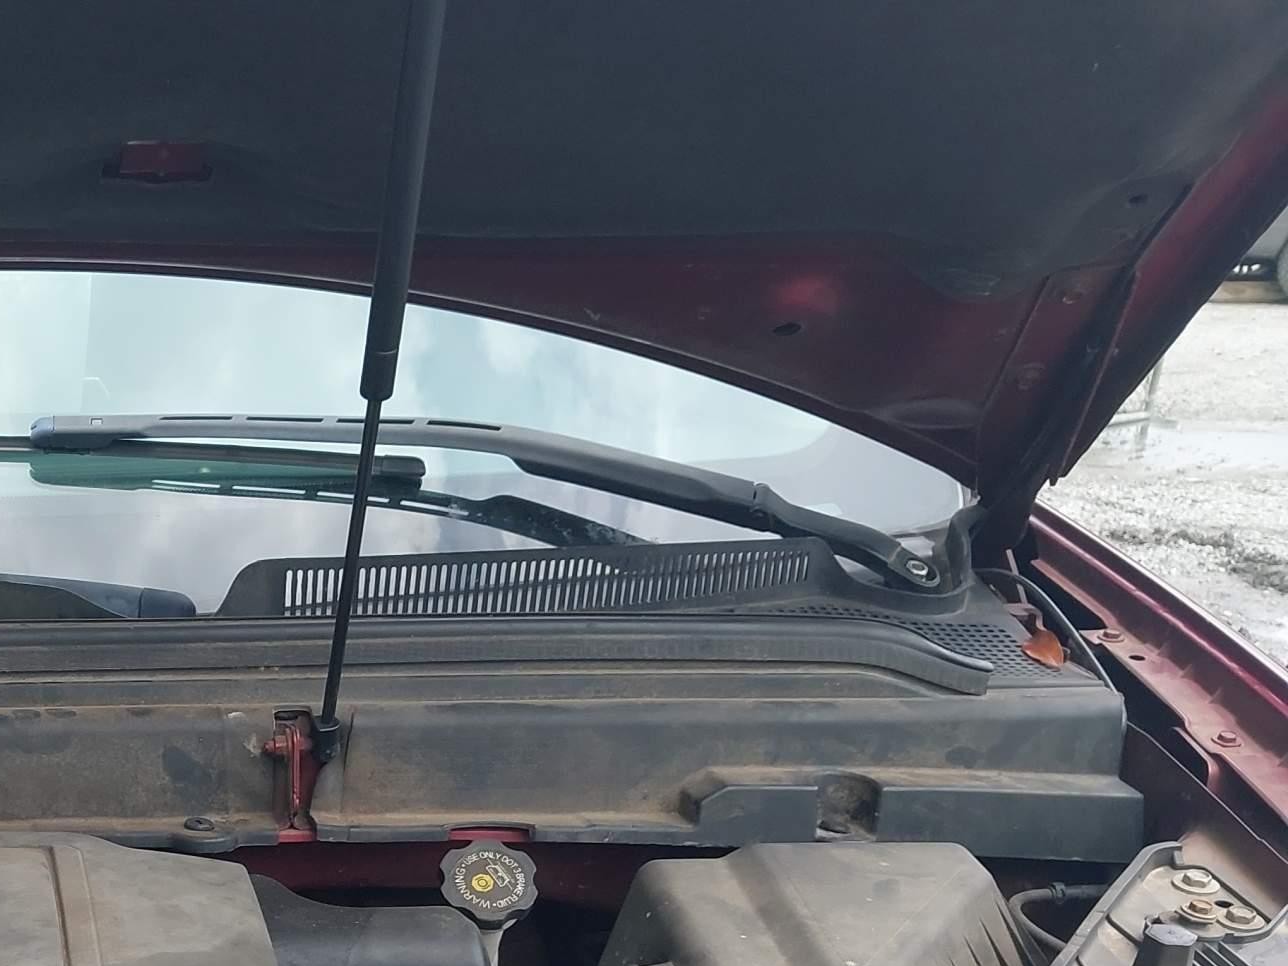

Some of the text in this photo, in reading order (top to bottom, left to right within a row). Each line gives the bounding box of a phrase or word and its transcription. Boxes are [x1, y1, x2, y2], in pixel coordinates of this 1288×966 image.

[463, 853, 480, 866] USE
[479, 851, 502, 860] ONLY
[501, 855, 519, 868] DOT
[454, 867, 491, 909] WARNING
[513, 873, 527, 897] BRAKE
[496, 893, 519, 909] FLUID
